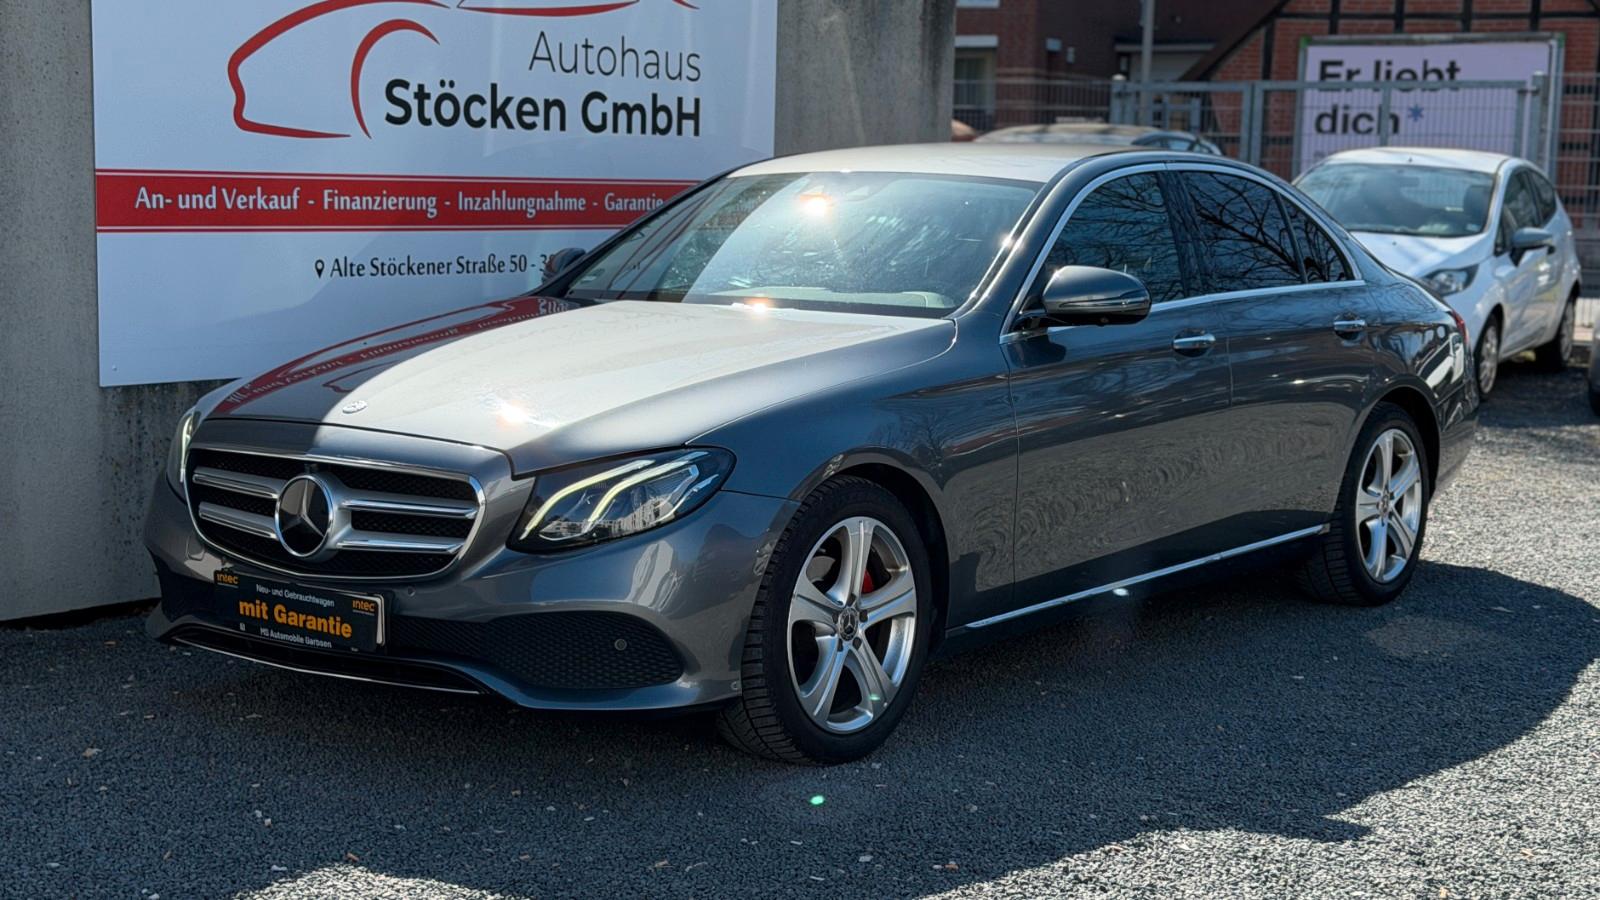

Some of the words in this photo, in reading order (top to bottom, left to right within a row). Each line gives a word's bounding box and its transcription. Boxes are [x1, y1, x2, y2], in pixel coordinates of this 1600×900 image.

[529, 31, 701, 81] Autohaus
[1319, 60, 1361, 92] Er
[1372, 60, 1461, 92] liebt
[385, 78, 566, 131] Stöcken
[581, 91, 700, 136] GmbH
[135, 186, 172, 209] An-
[178, 186, 217, 209] und
[221, 187, 301, 210] Verkauf
[323, 189, 437, 218] Finanzierung
[458, 190, 586, 218] Inzahlungnahme
[604, 193, 664, 211] Garantie
[330, 256, 365, 277] Alte
[370, 255, 452, 276] Stöckener
[456, 253, 505, 275] Straße
[510, 254, 527, 273] 50
[239, 599, 269, 620] mit
[274, 604, 352, 638] Garantie
